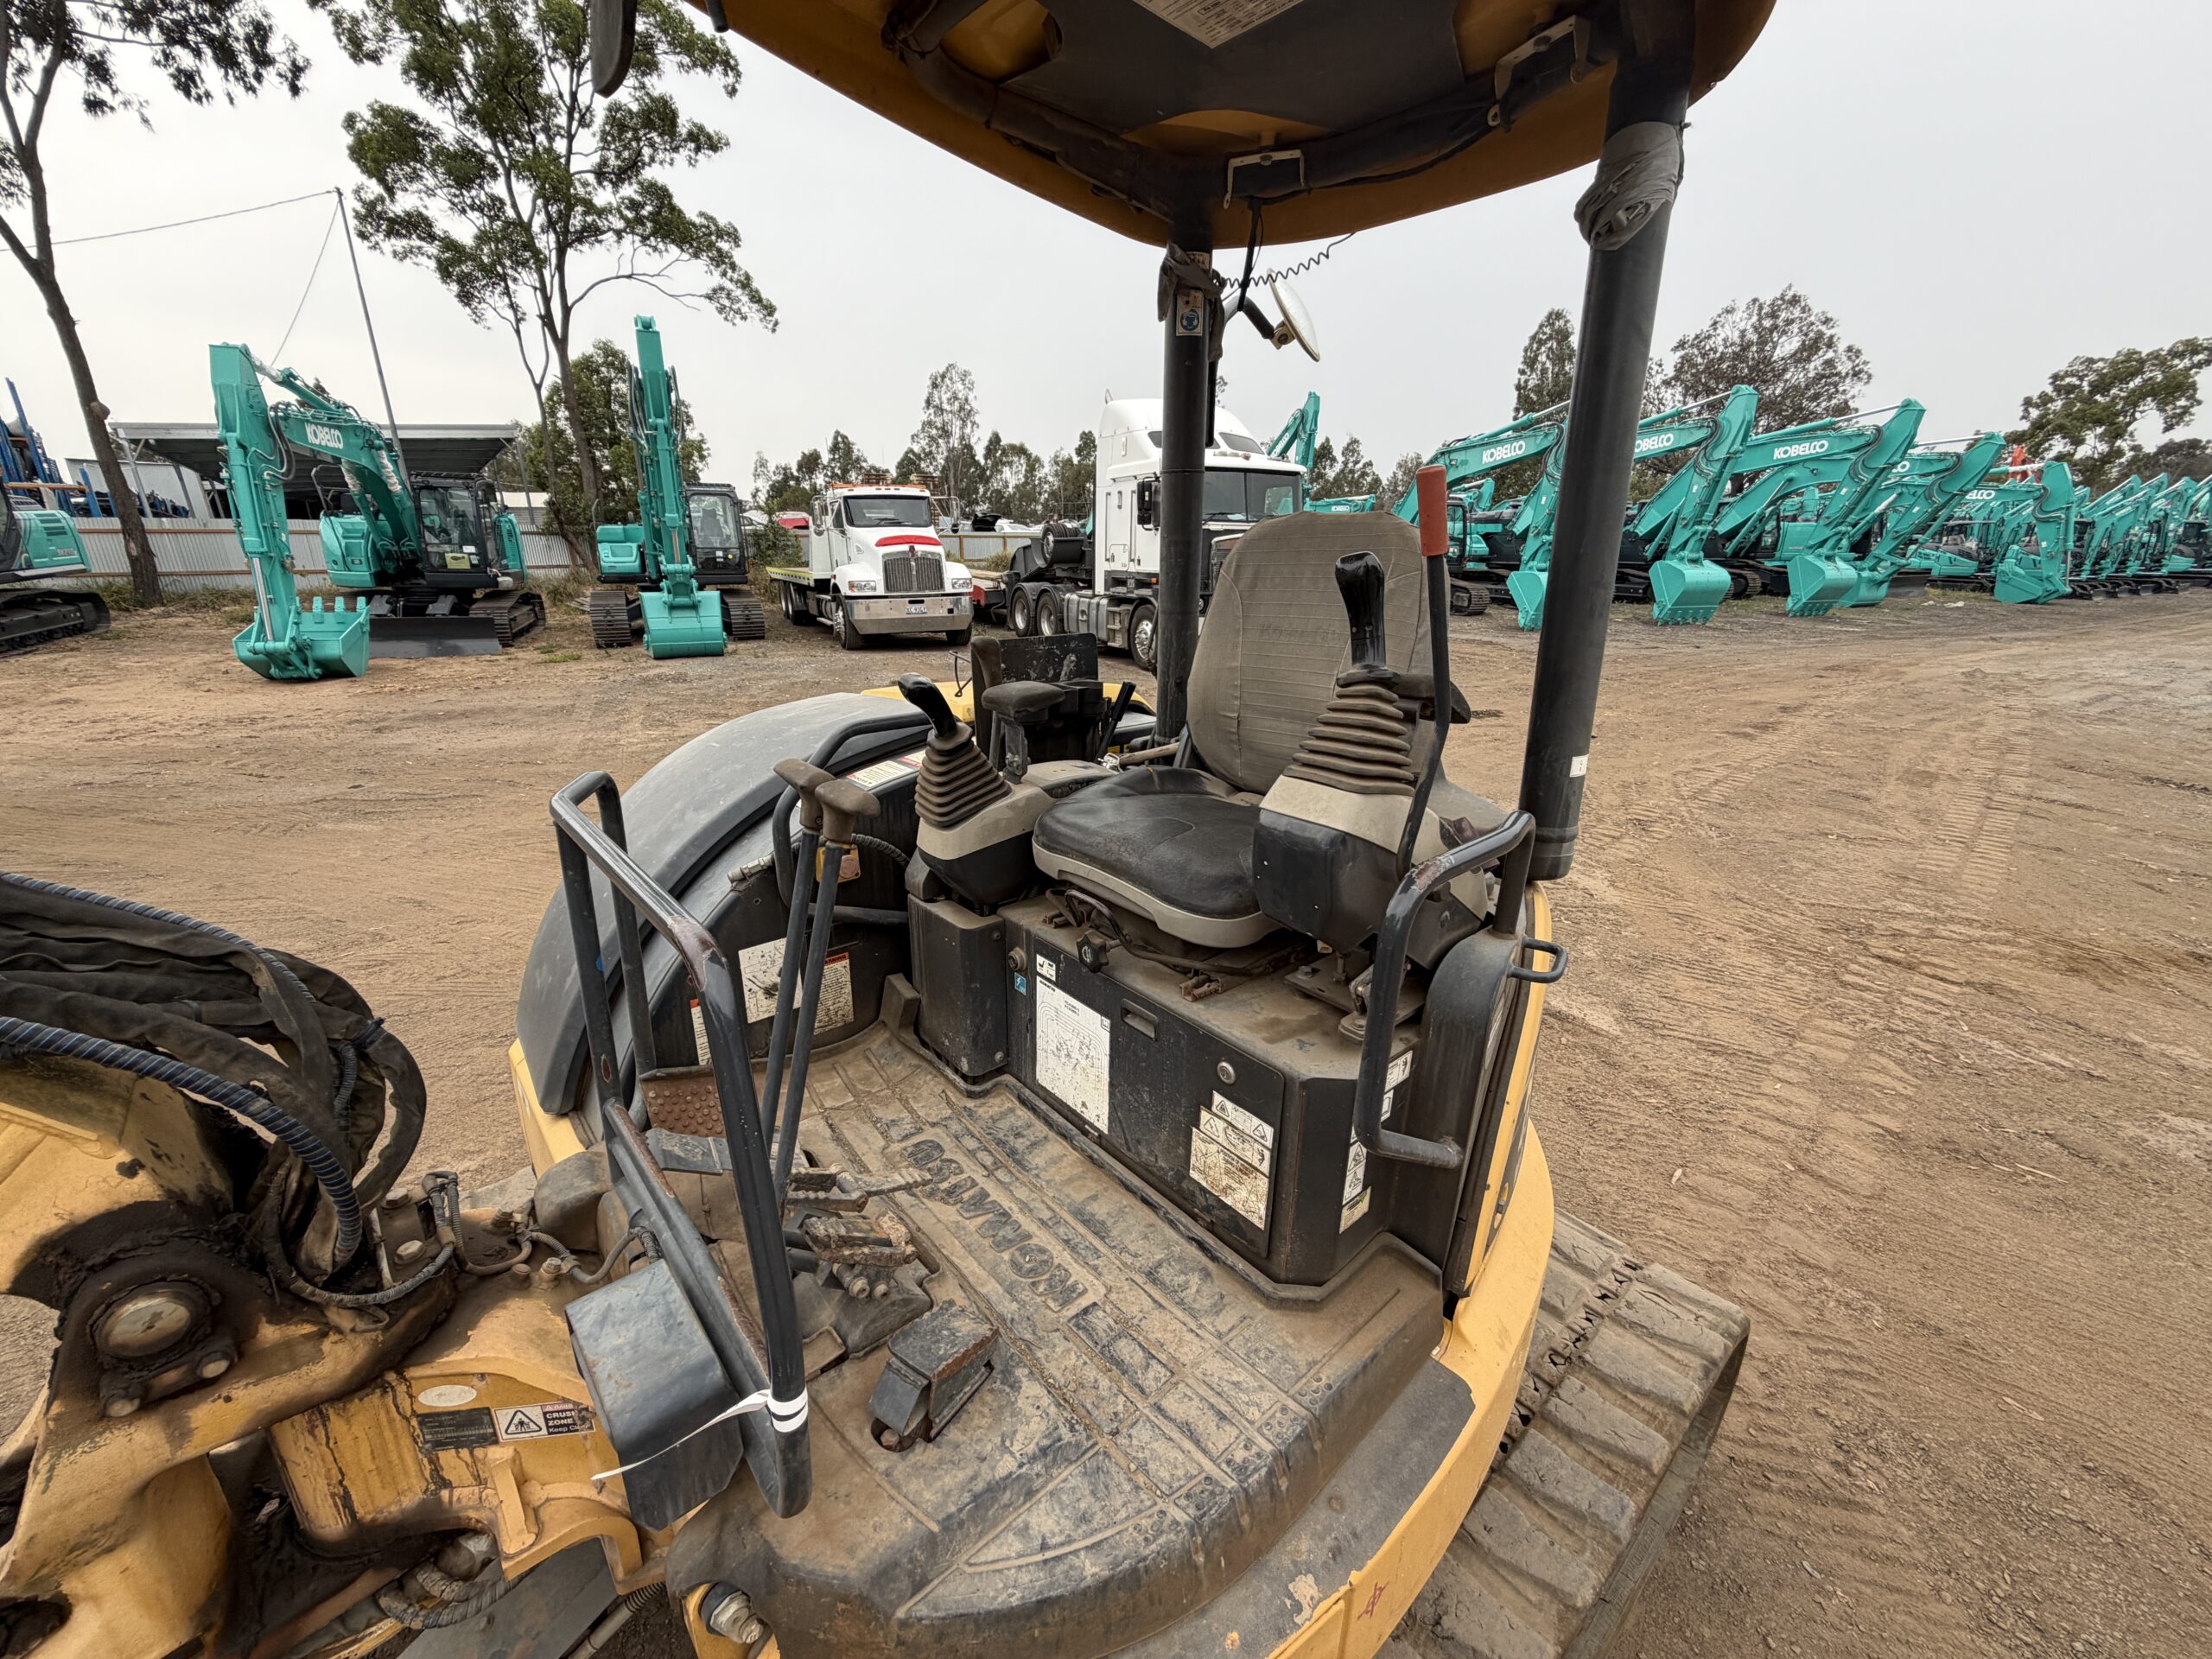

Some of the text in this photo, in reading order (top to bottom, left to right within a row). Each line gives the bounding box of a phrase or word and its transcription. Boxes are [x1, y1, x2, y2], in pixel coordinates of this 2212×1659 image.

[304, 422, 344, 449] KOBELCO
[1635, 434, 1675, 453] OBELCO
[1482, 441, 1526, 464] KOBELCO
[1773, 440, 1829, 461] KOBELCO
[1966, 490, 1996, 500] ELCO
[824, 954, 847, 964] ARNING
